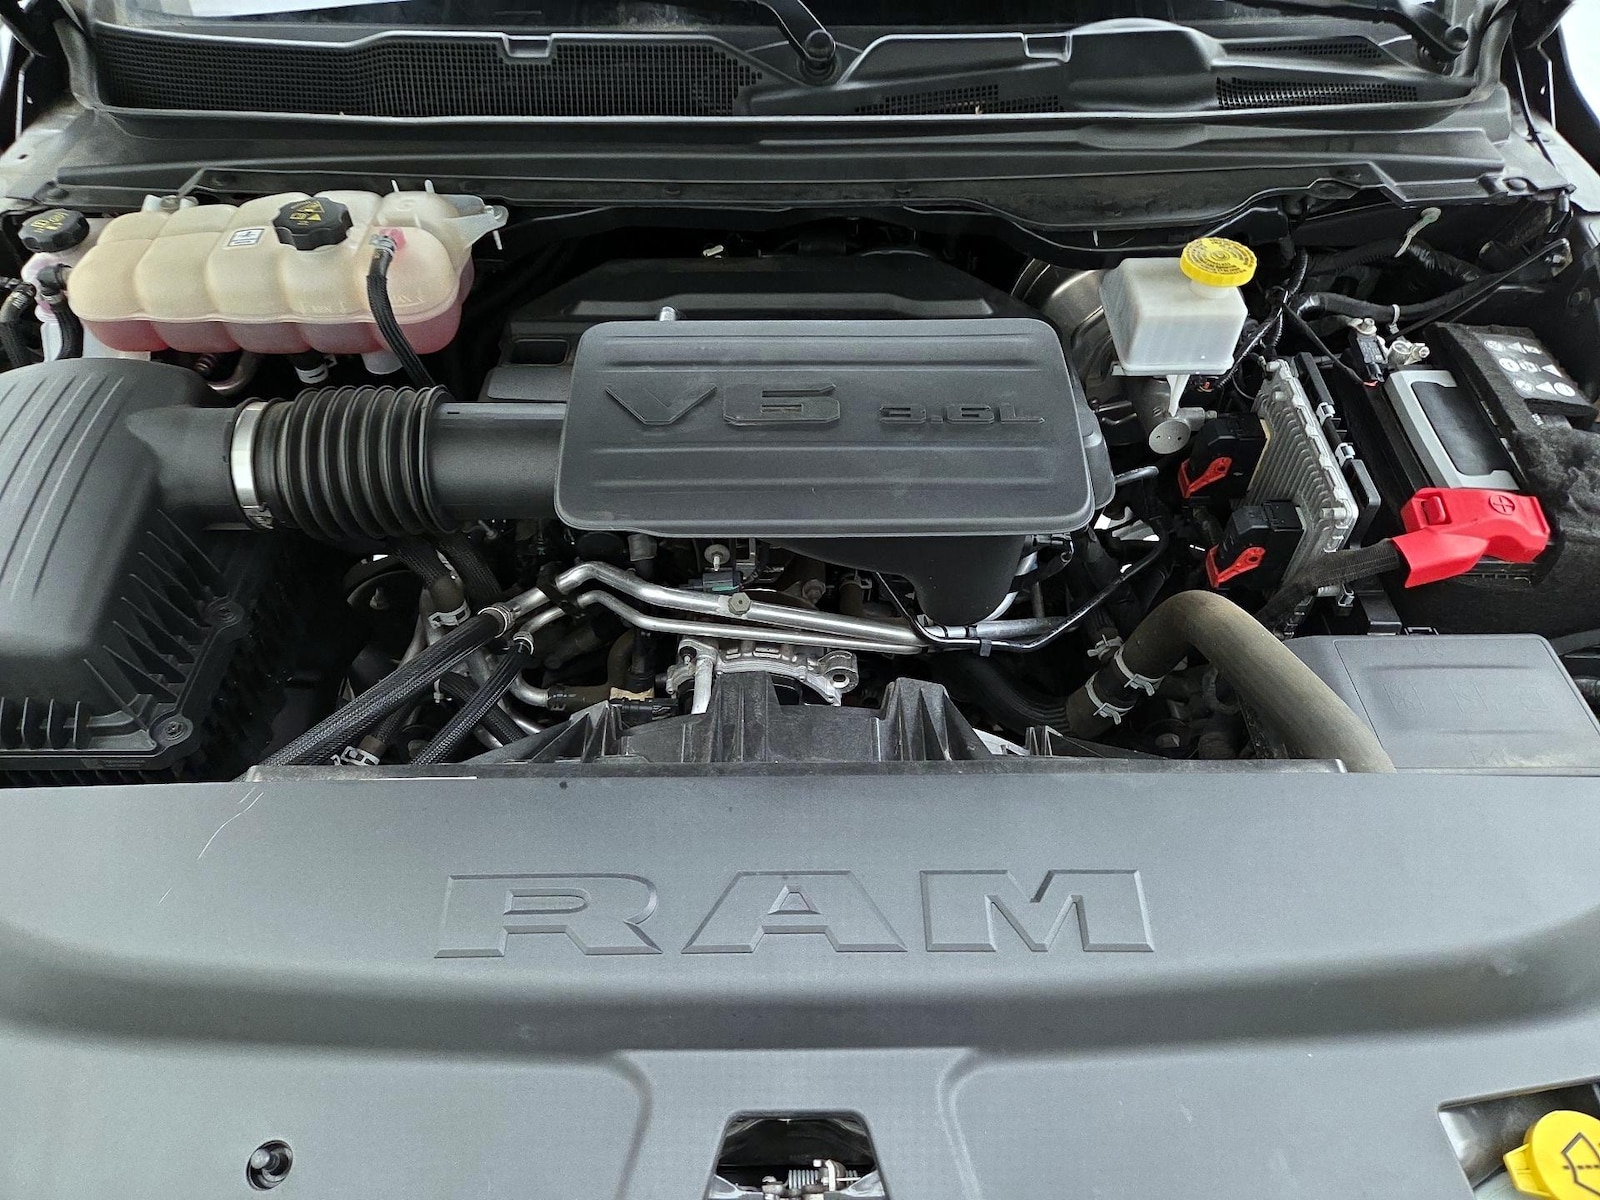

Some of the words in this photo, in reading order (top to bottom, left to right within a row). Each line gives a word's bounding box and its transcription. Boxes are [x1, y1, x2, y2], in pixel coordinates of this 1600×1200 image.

[605, 383, 840, 426] V6
[879, 402, 1046, 425] 3.6L
[435, 869, 1155, 957] RAM
